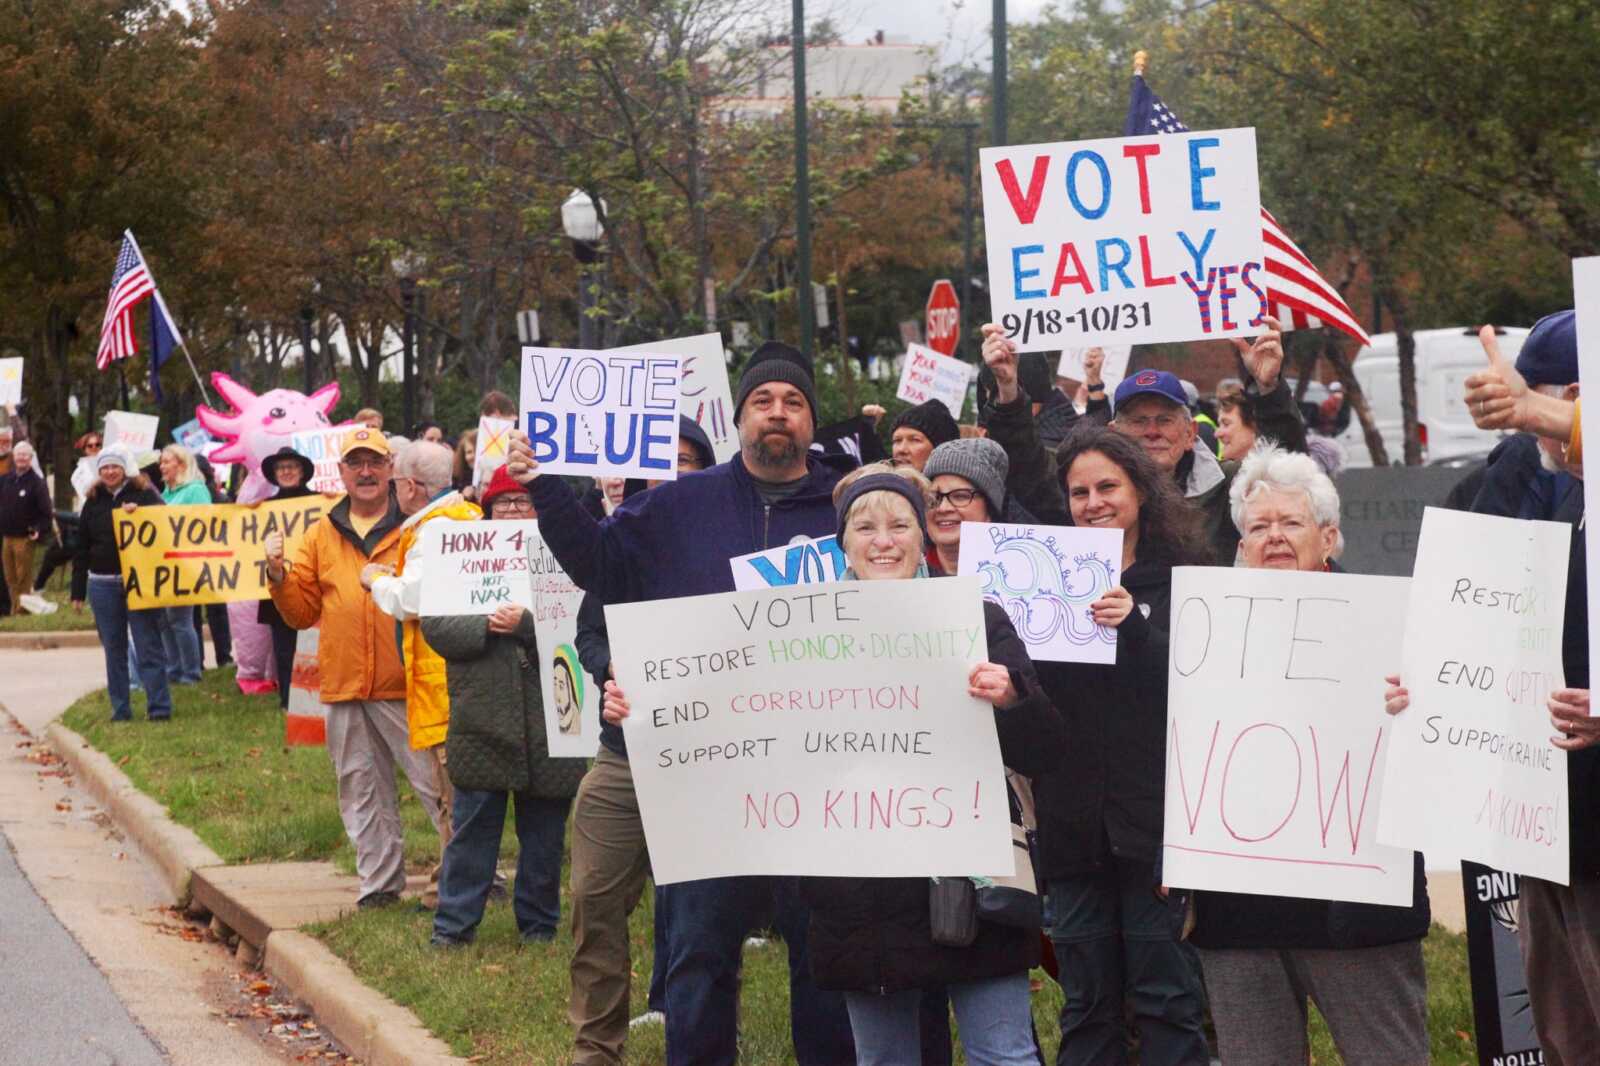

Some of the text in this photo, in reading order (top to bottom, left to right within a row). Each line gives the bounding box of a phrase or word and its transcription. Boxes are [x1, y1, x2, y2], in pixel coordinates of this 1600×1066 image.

[995, 137, 1221, 225] VOTE
[1011, 228, 1217, 301] EARLY
[1179, 261, 1269, 334] YES
[928, 308, 959, 339] STOP
[1001, 301, 1153, 345] 9/18-10/31
[530, 353, 679, 410] VOTE
[526, 410, 675, 471] BLUE
[118, 519, 158, 551] DO
[168, 515, 229, 548] YOU
[441, 529, 528, 555] HONK 4
[988, 525, 1035, 546] BLUE
[125, 565, 143, 599] A
[153, 559, 242, 598] PLAN
[470, 586, 513, 606] WAR
[732, 589, 861, 632] VOTE
[643, 644, 757, 683] RESTORE
[768, 632, 856, 664] HONOR
[870, 624, 981, 660] DIGNITY
[1172, 593, 1350, 683] OTE
[1437, 660, 1496, 692] END
[653, 683, 921, 729] END CORRUPTION
[657, 729, 933, 769] SUPPORT UKRAINE
[743, 790, 801, 831] NO
[1476, 871, 1520, 902] ING
